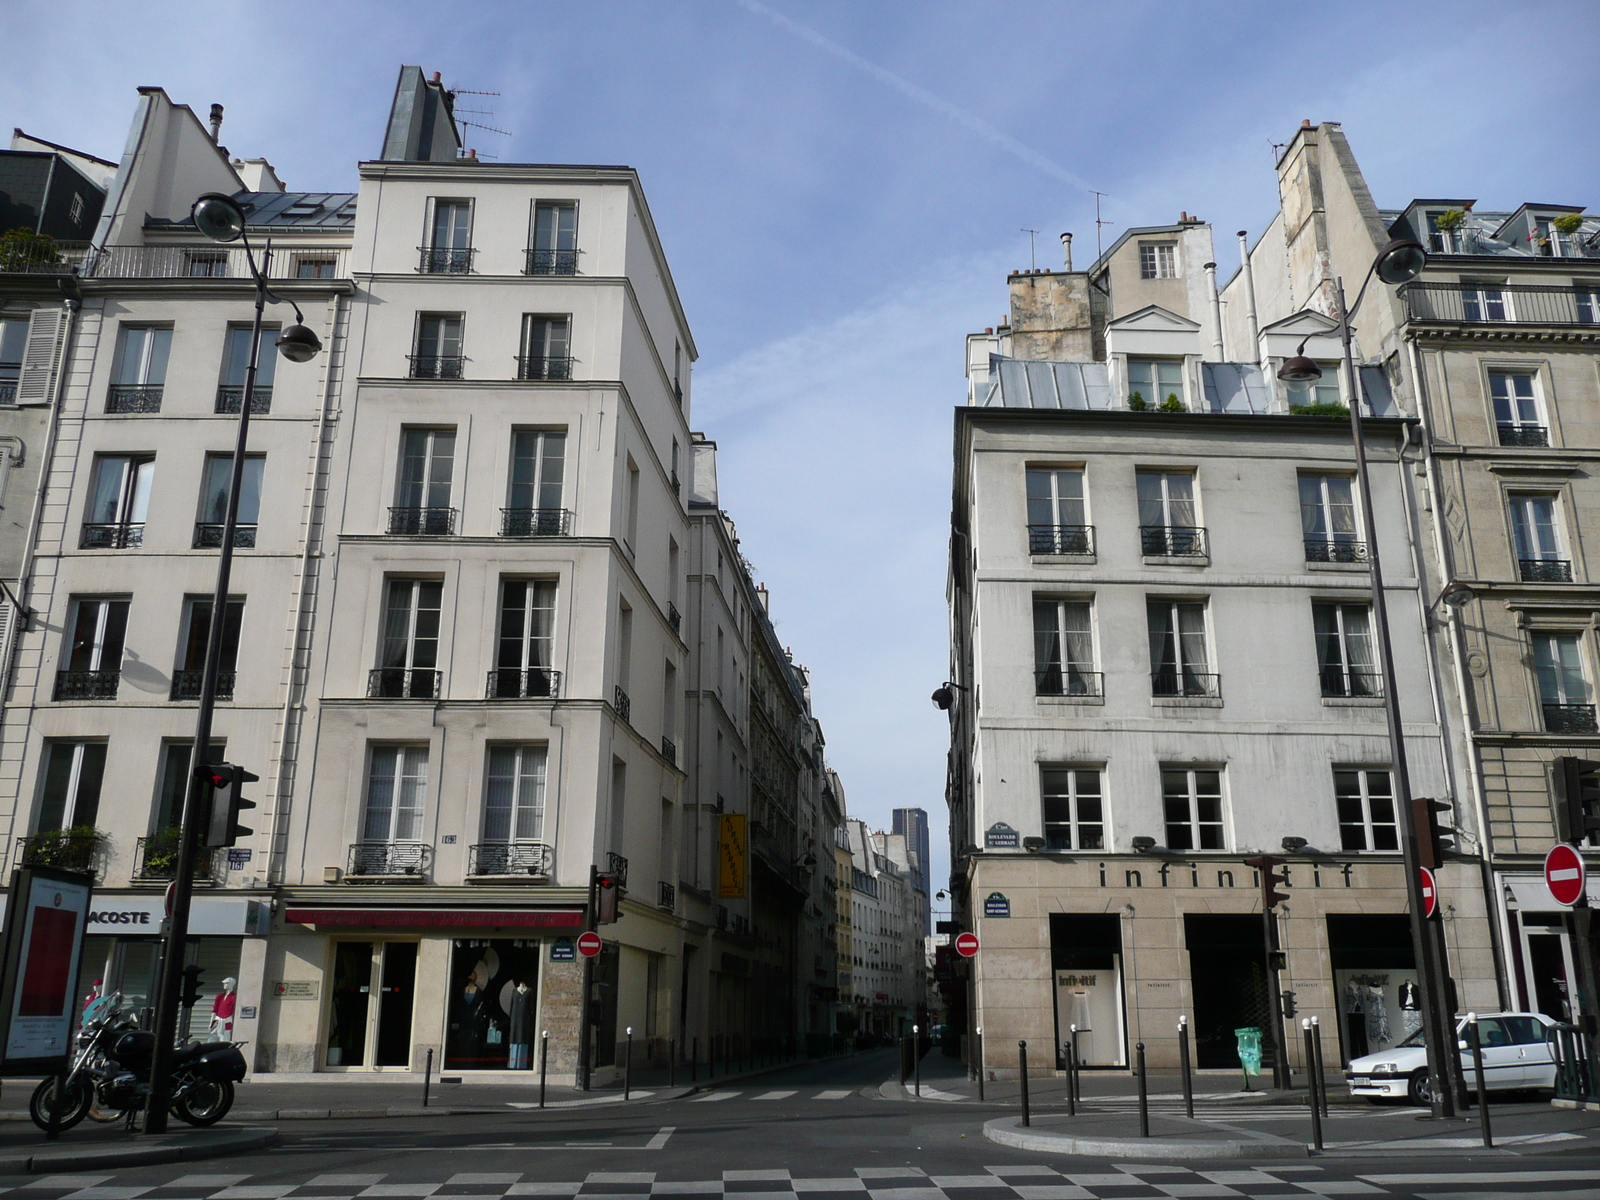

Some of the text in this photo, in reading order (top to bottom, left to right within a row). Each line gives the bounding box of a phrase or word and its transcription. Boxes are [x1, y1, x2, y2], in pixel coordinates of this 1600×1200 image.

[442, 835, 457, 844] 163
[725, 816, 744, 856] KOREAN
[231, 861, 243, 870] 161
[722, 843, 744, 894] BARBECUE
[1099, 862, 1353, 888] infinitif
[87, 911, 151, 924] ACOSTE
